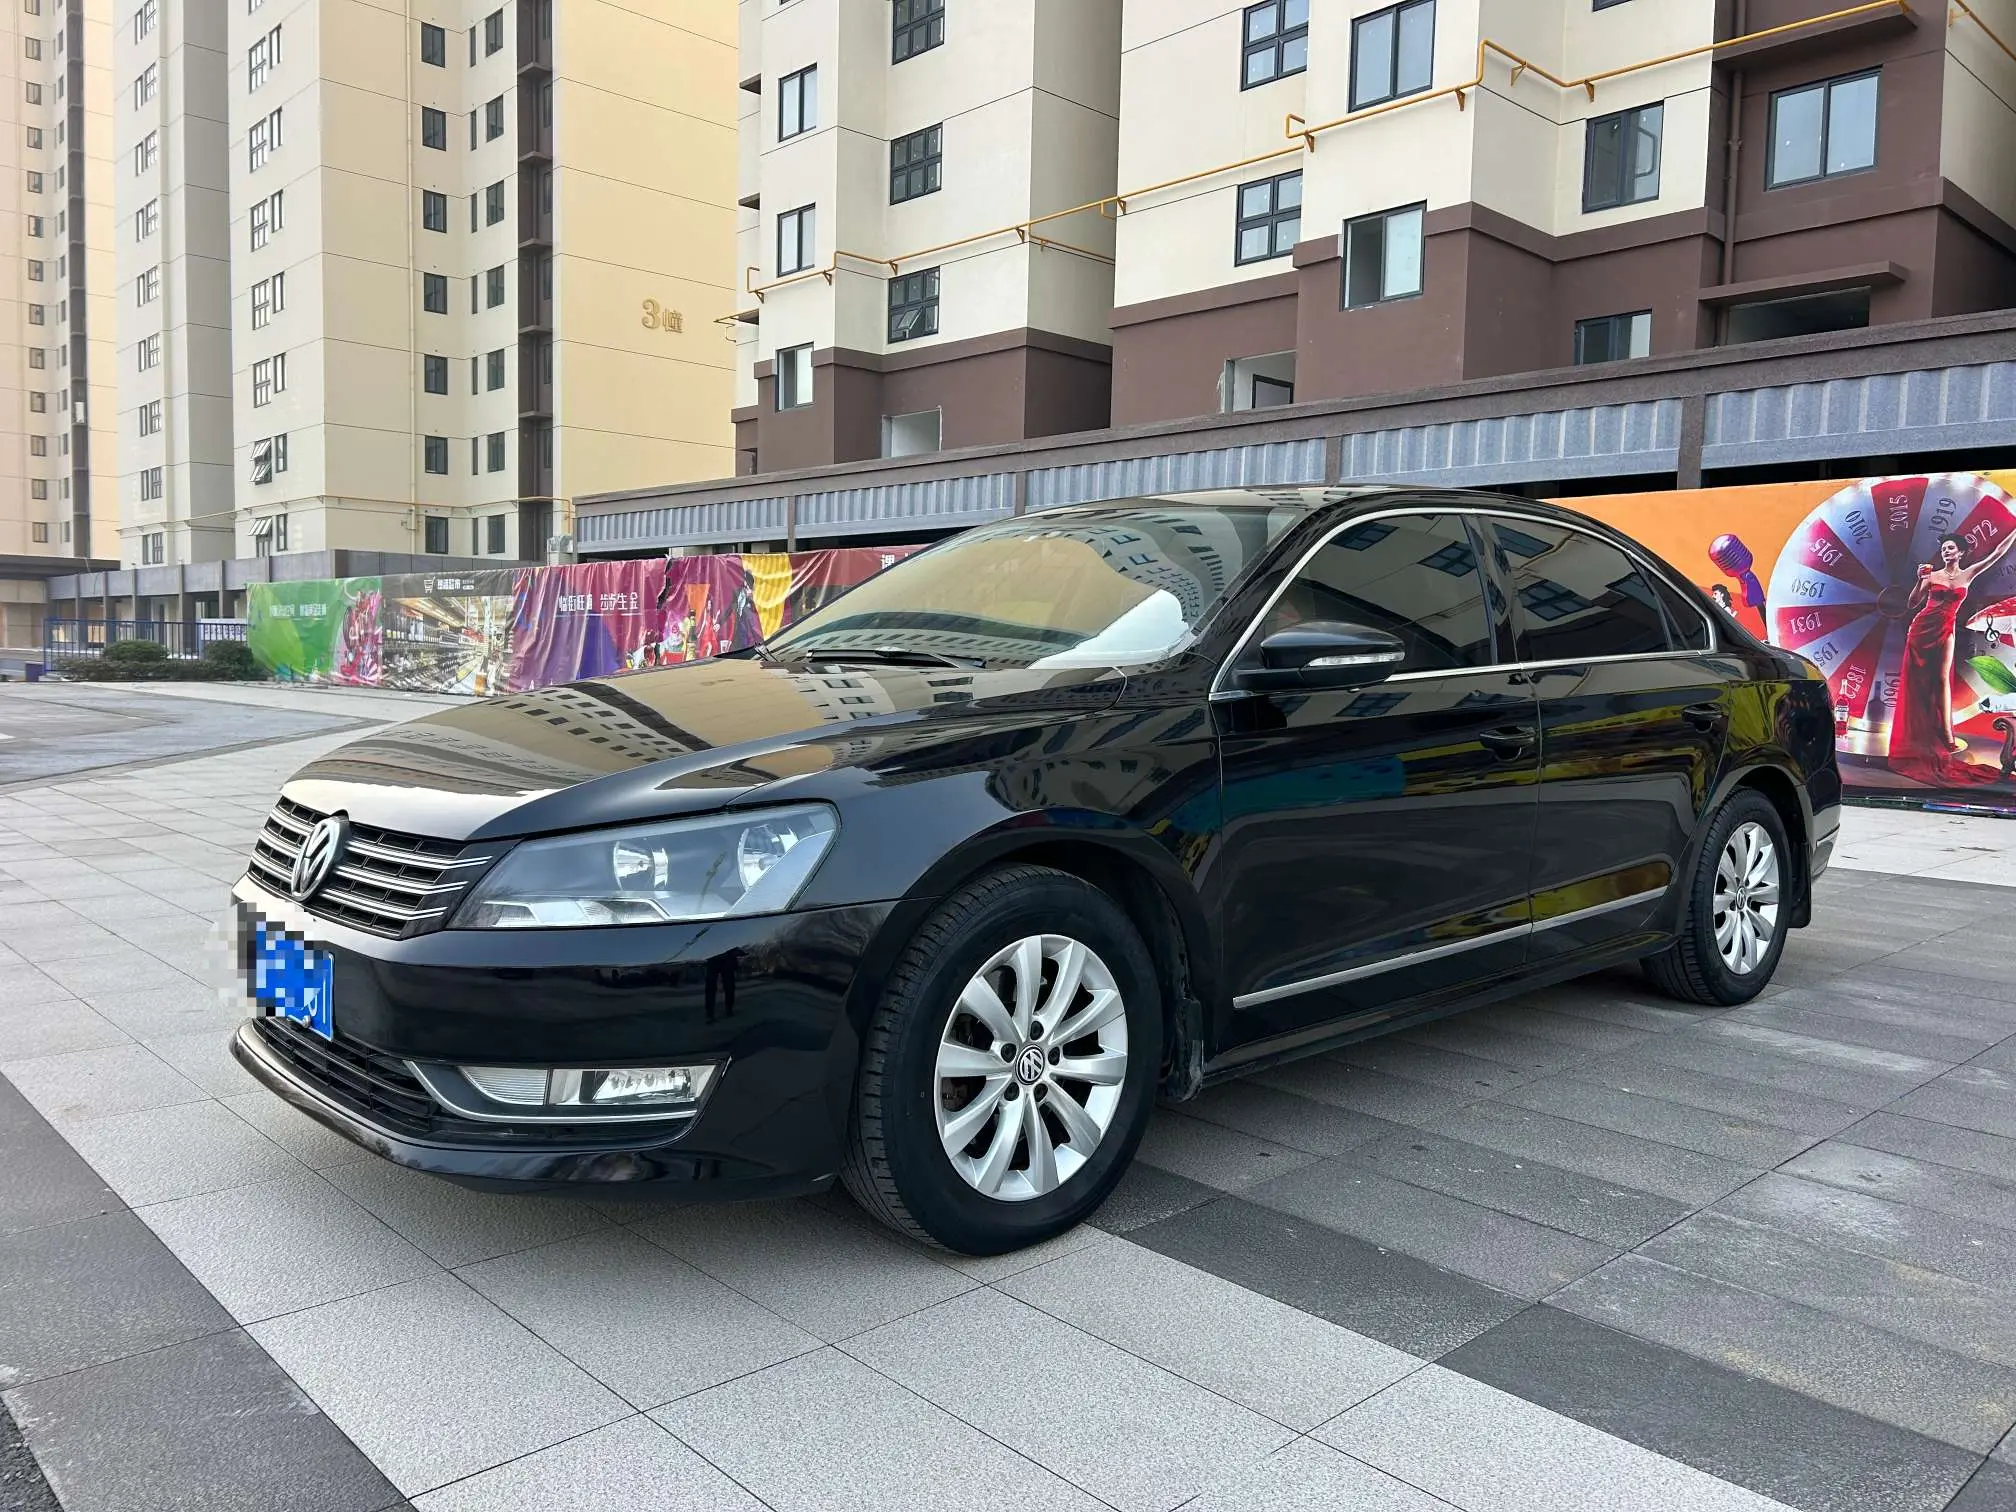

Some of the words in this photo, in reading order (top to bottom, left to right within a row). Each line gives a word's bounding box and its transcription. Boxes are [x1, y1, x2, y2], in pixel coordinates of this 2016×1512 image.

[641, 299, 683, 334] 3幢
[1844, 510, 1873, 545] 2010
[1964, 519, 1999, 549] 972
[1809, 537, 1843, 567] 1915
[600, 592, 639, 611] 步步生金
[1789, 611, 1822, 635] 1931
[1813, 641, 1840, 667] 195
